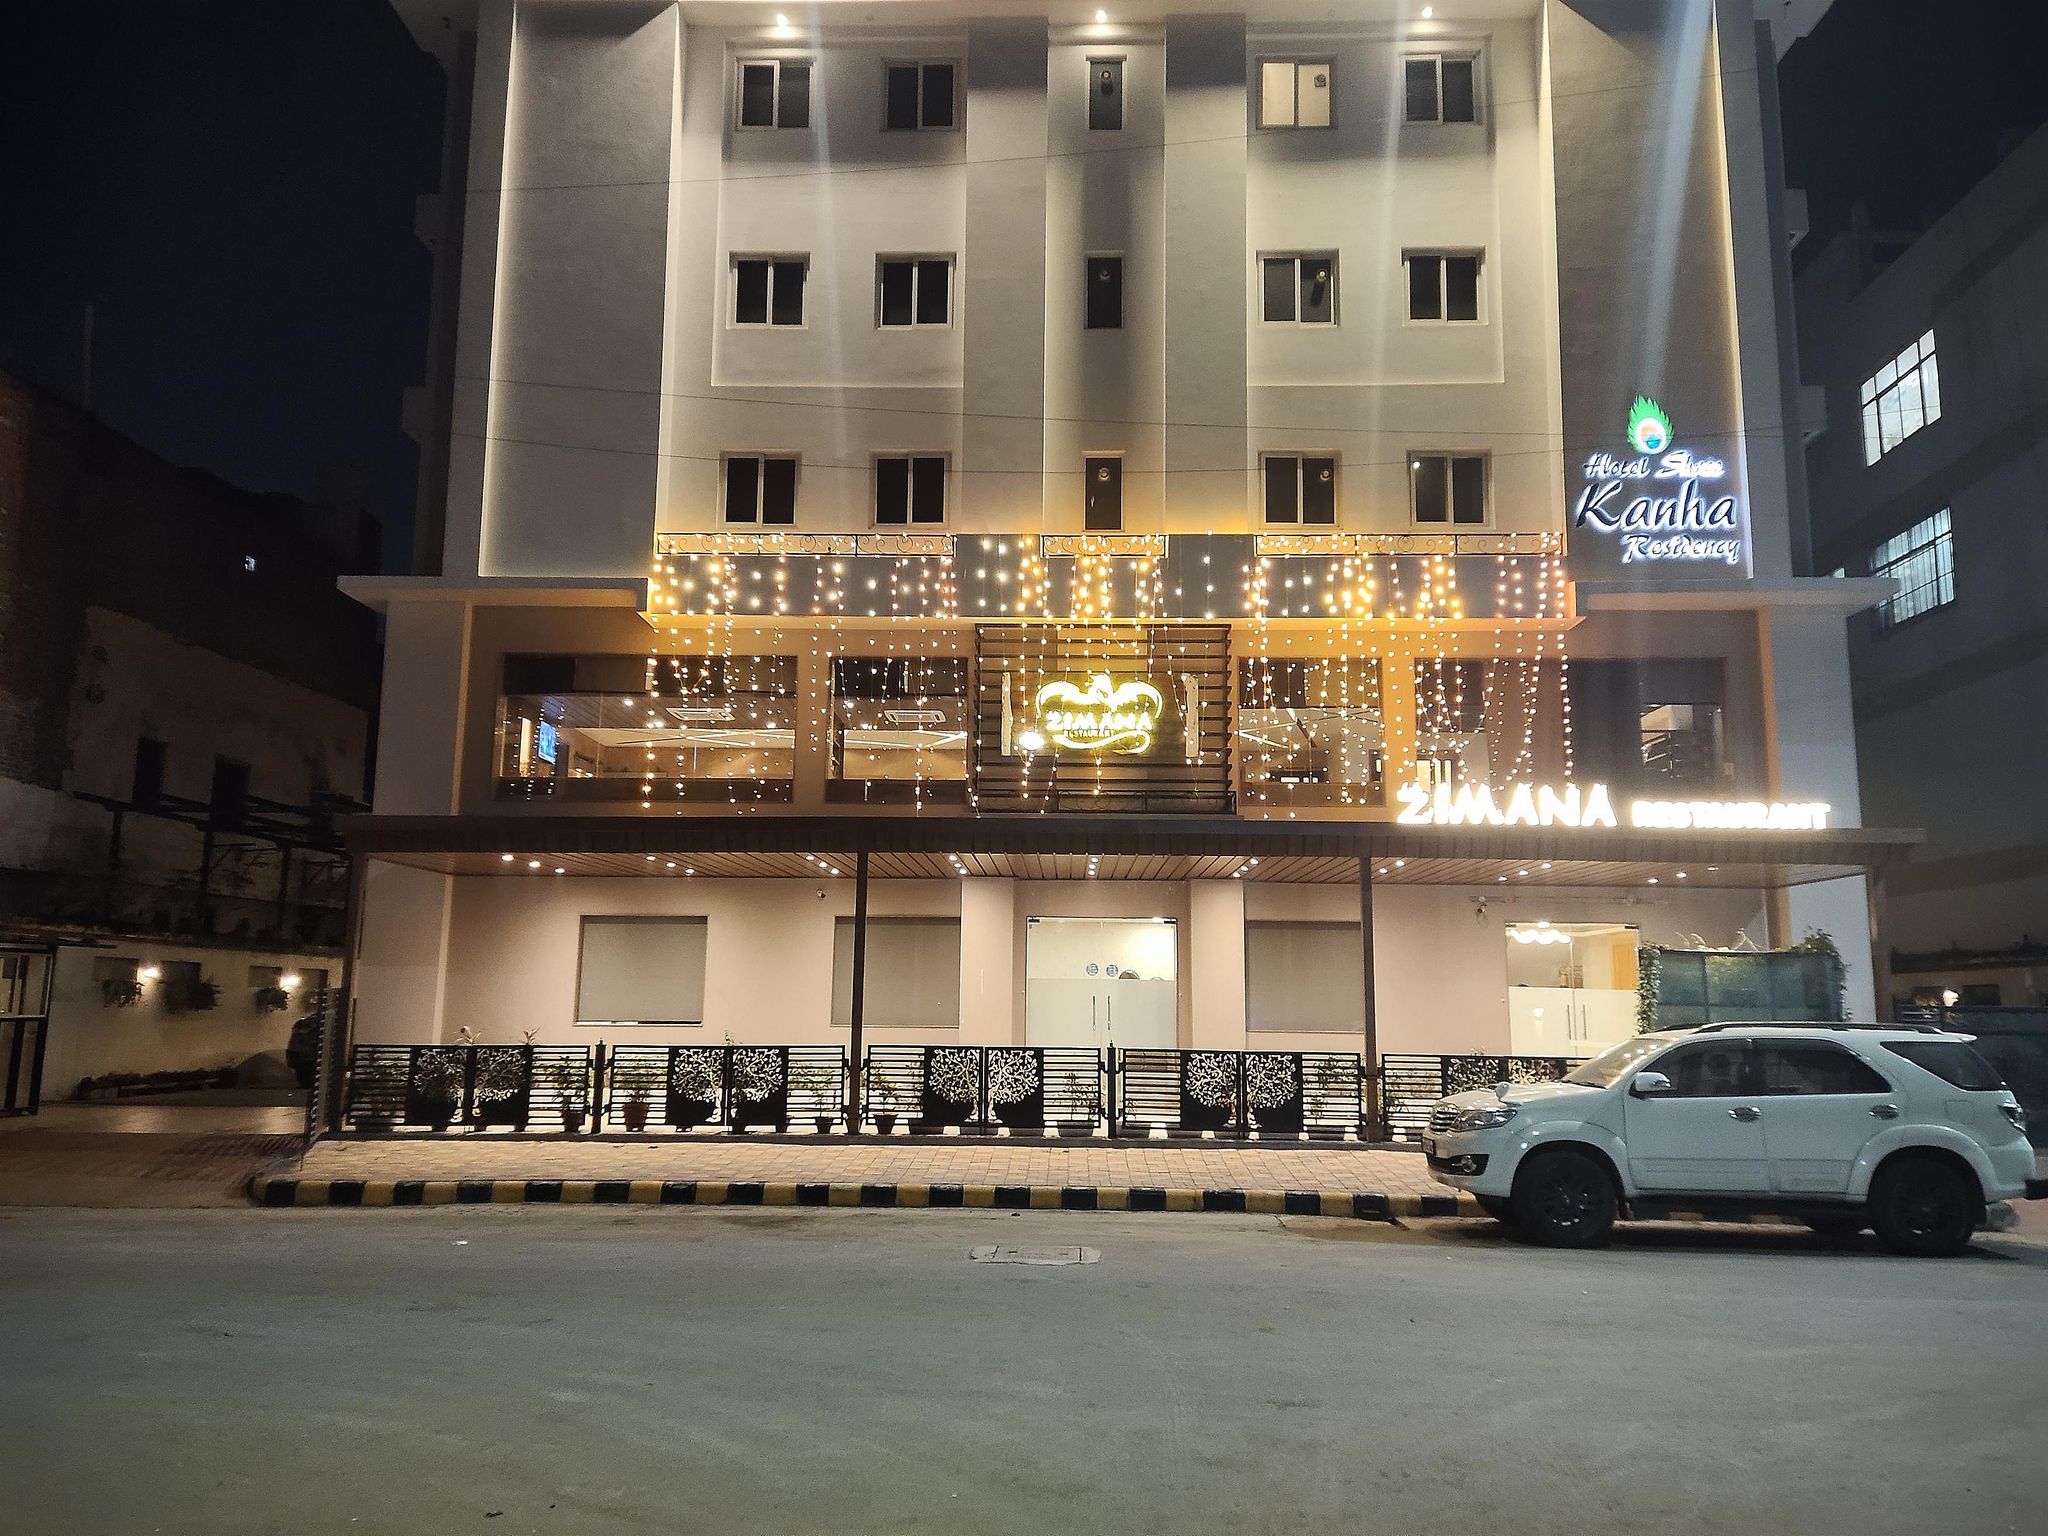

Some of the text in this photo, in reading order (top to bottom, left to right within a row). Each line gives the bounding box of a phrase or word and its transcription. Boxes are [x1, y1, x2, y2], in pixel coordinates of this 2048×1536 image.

[1583, 452, 1649, 478] Hotel
[1576, 478, 1737, 529] Kanha
[1622, 532, 1740, 564] Residency
[1046, 711, 1153, 731] ZIMANA
[1396, 783, 1619, 828] ZIMANA
